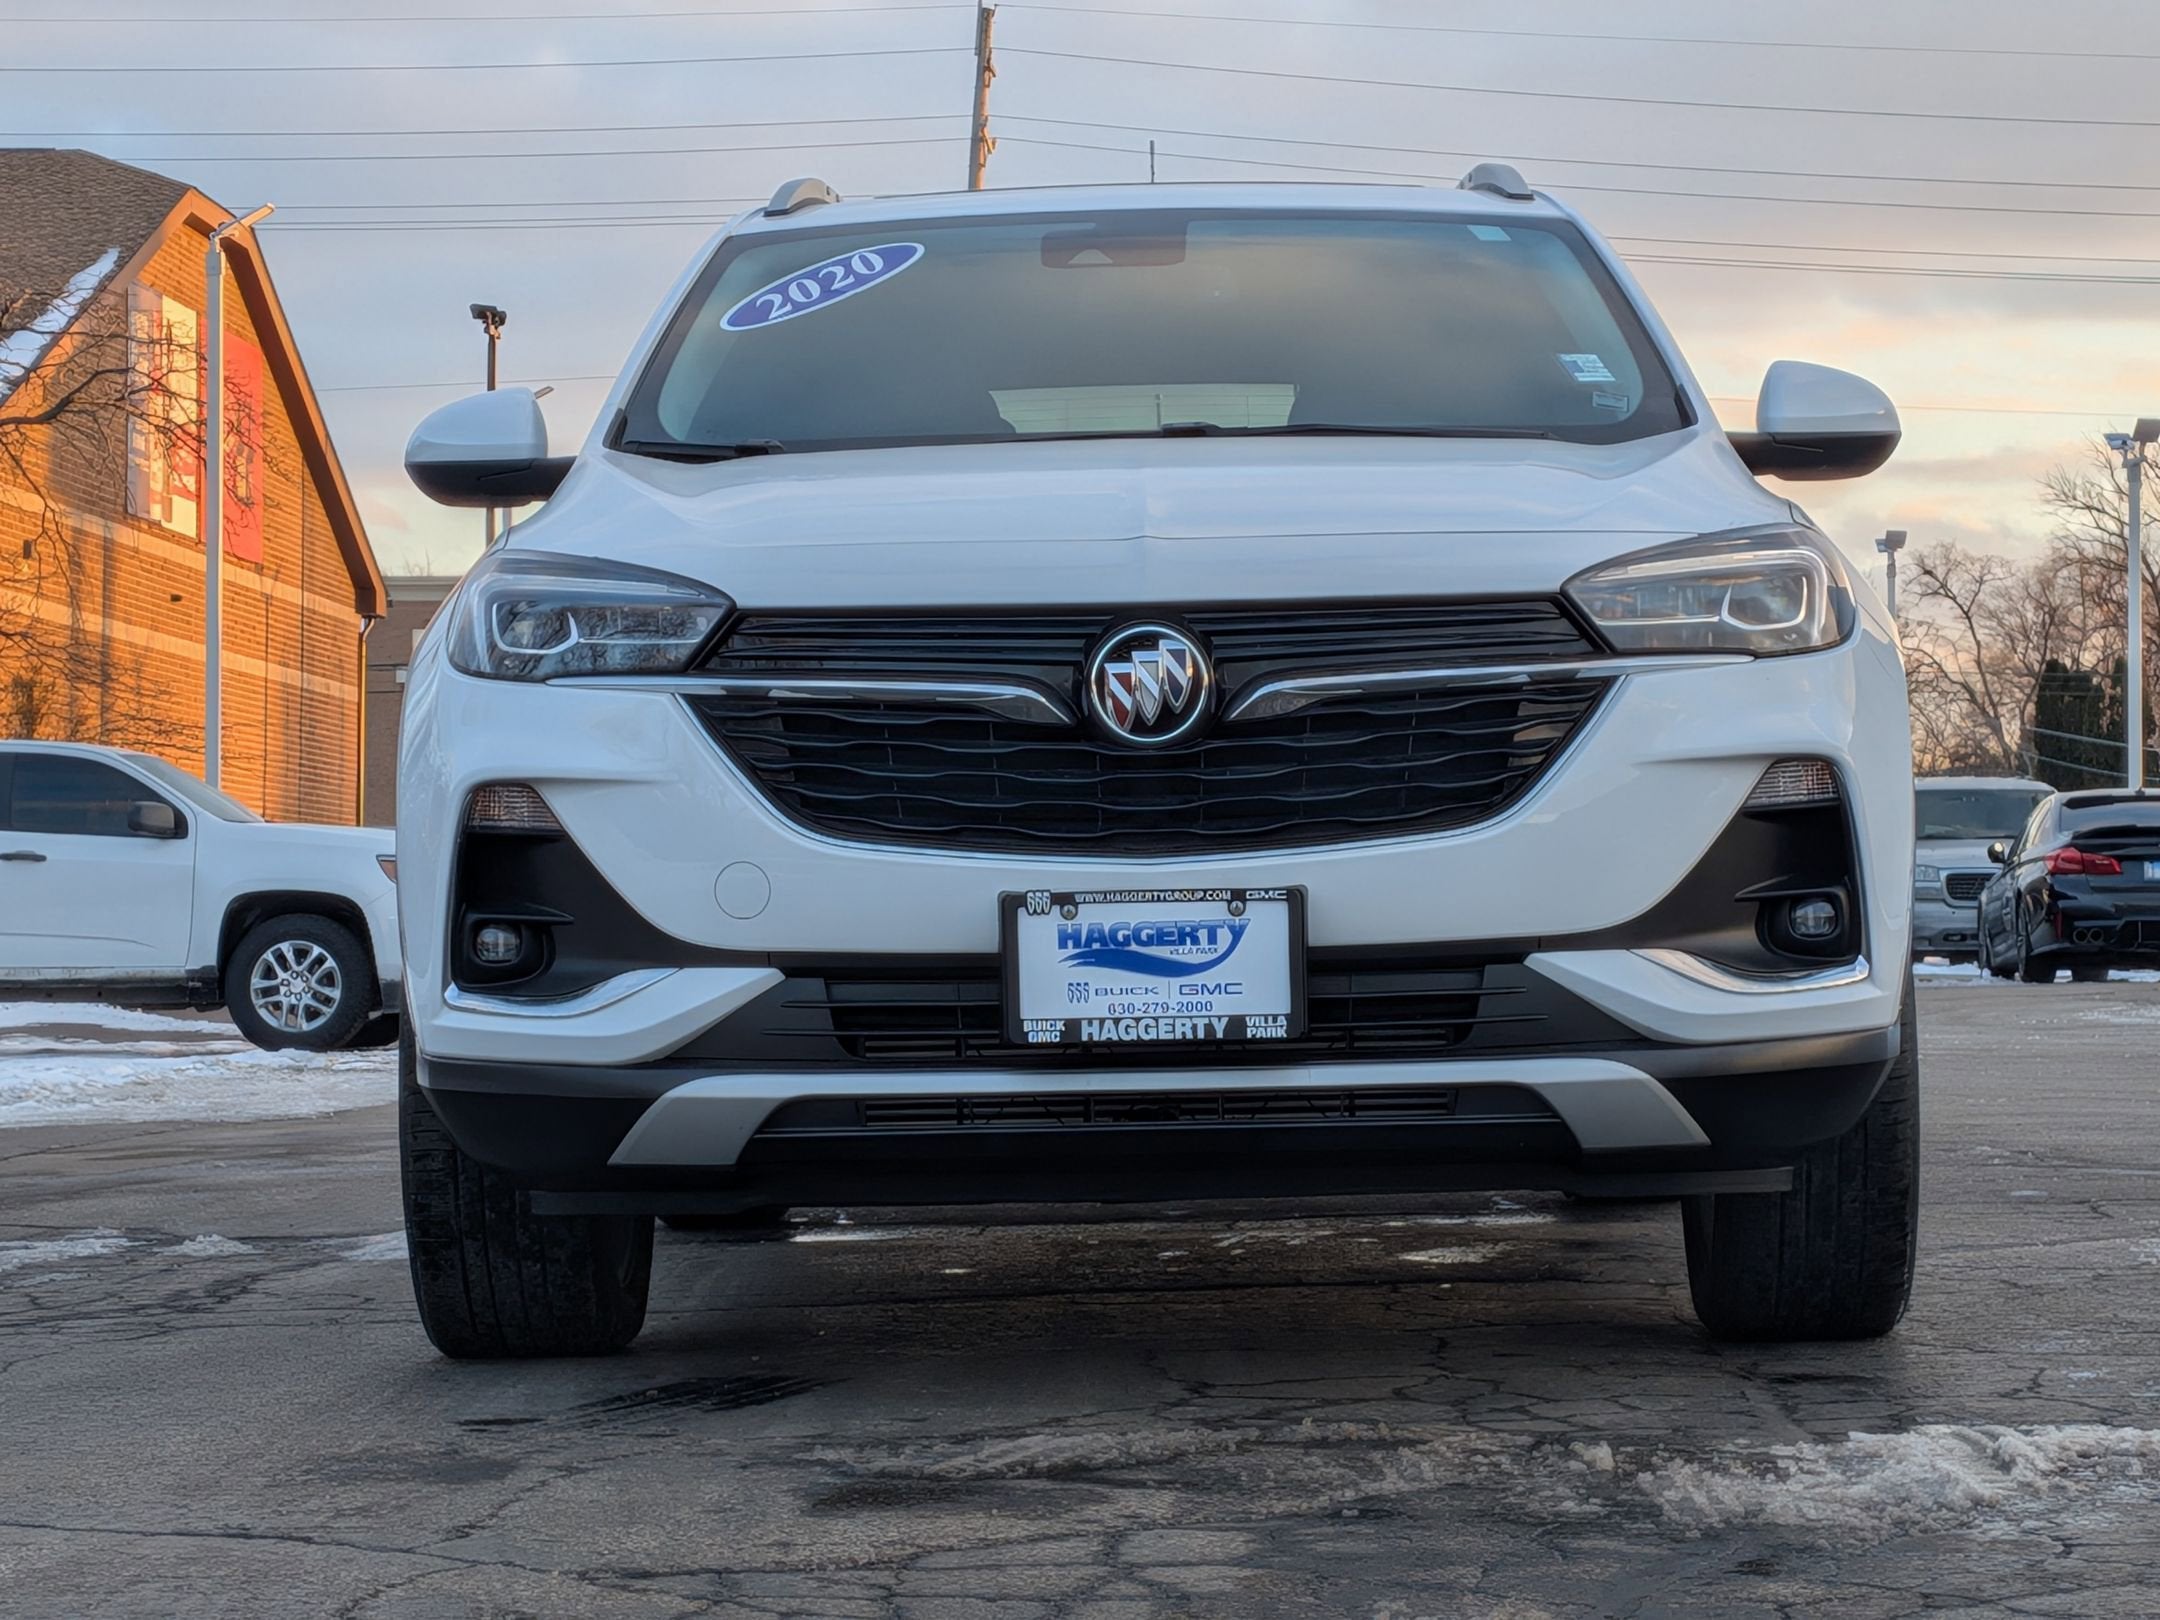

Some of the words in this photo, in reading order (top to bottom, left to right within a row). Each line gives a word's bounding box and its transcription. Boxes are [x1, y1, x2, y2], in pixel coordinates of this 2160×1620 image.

[756, 252, 884, 319] 2020
[1057, 918, 1251, 950] HAGGERTY
[1095, 986, 1160, 996] BUICK
[1179, 982, 1243, 996] GMC
[1024, 1020, 1066, 1032] BUICK
[1245, 1015, 1288, 1027] VILLA
[1081, 1016, 1230, 1042] HAGGERTY
[1246, 1027, 1288, 1039] PARK
